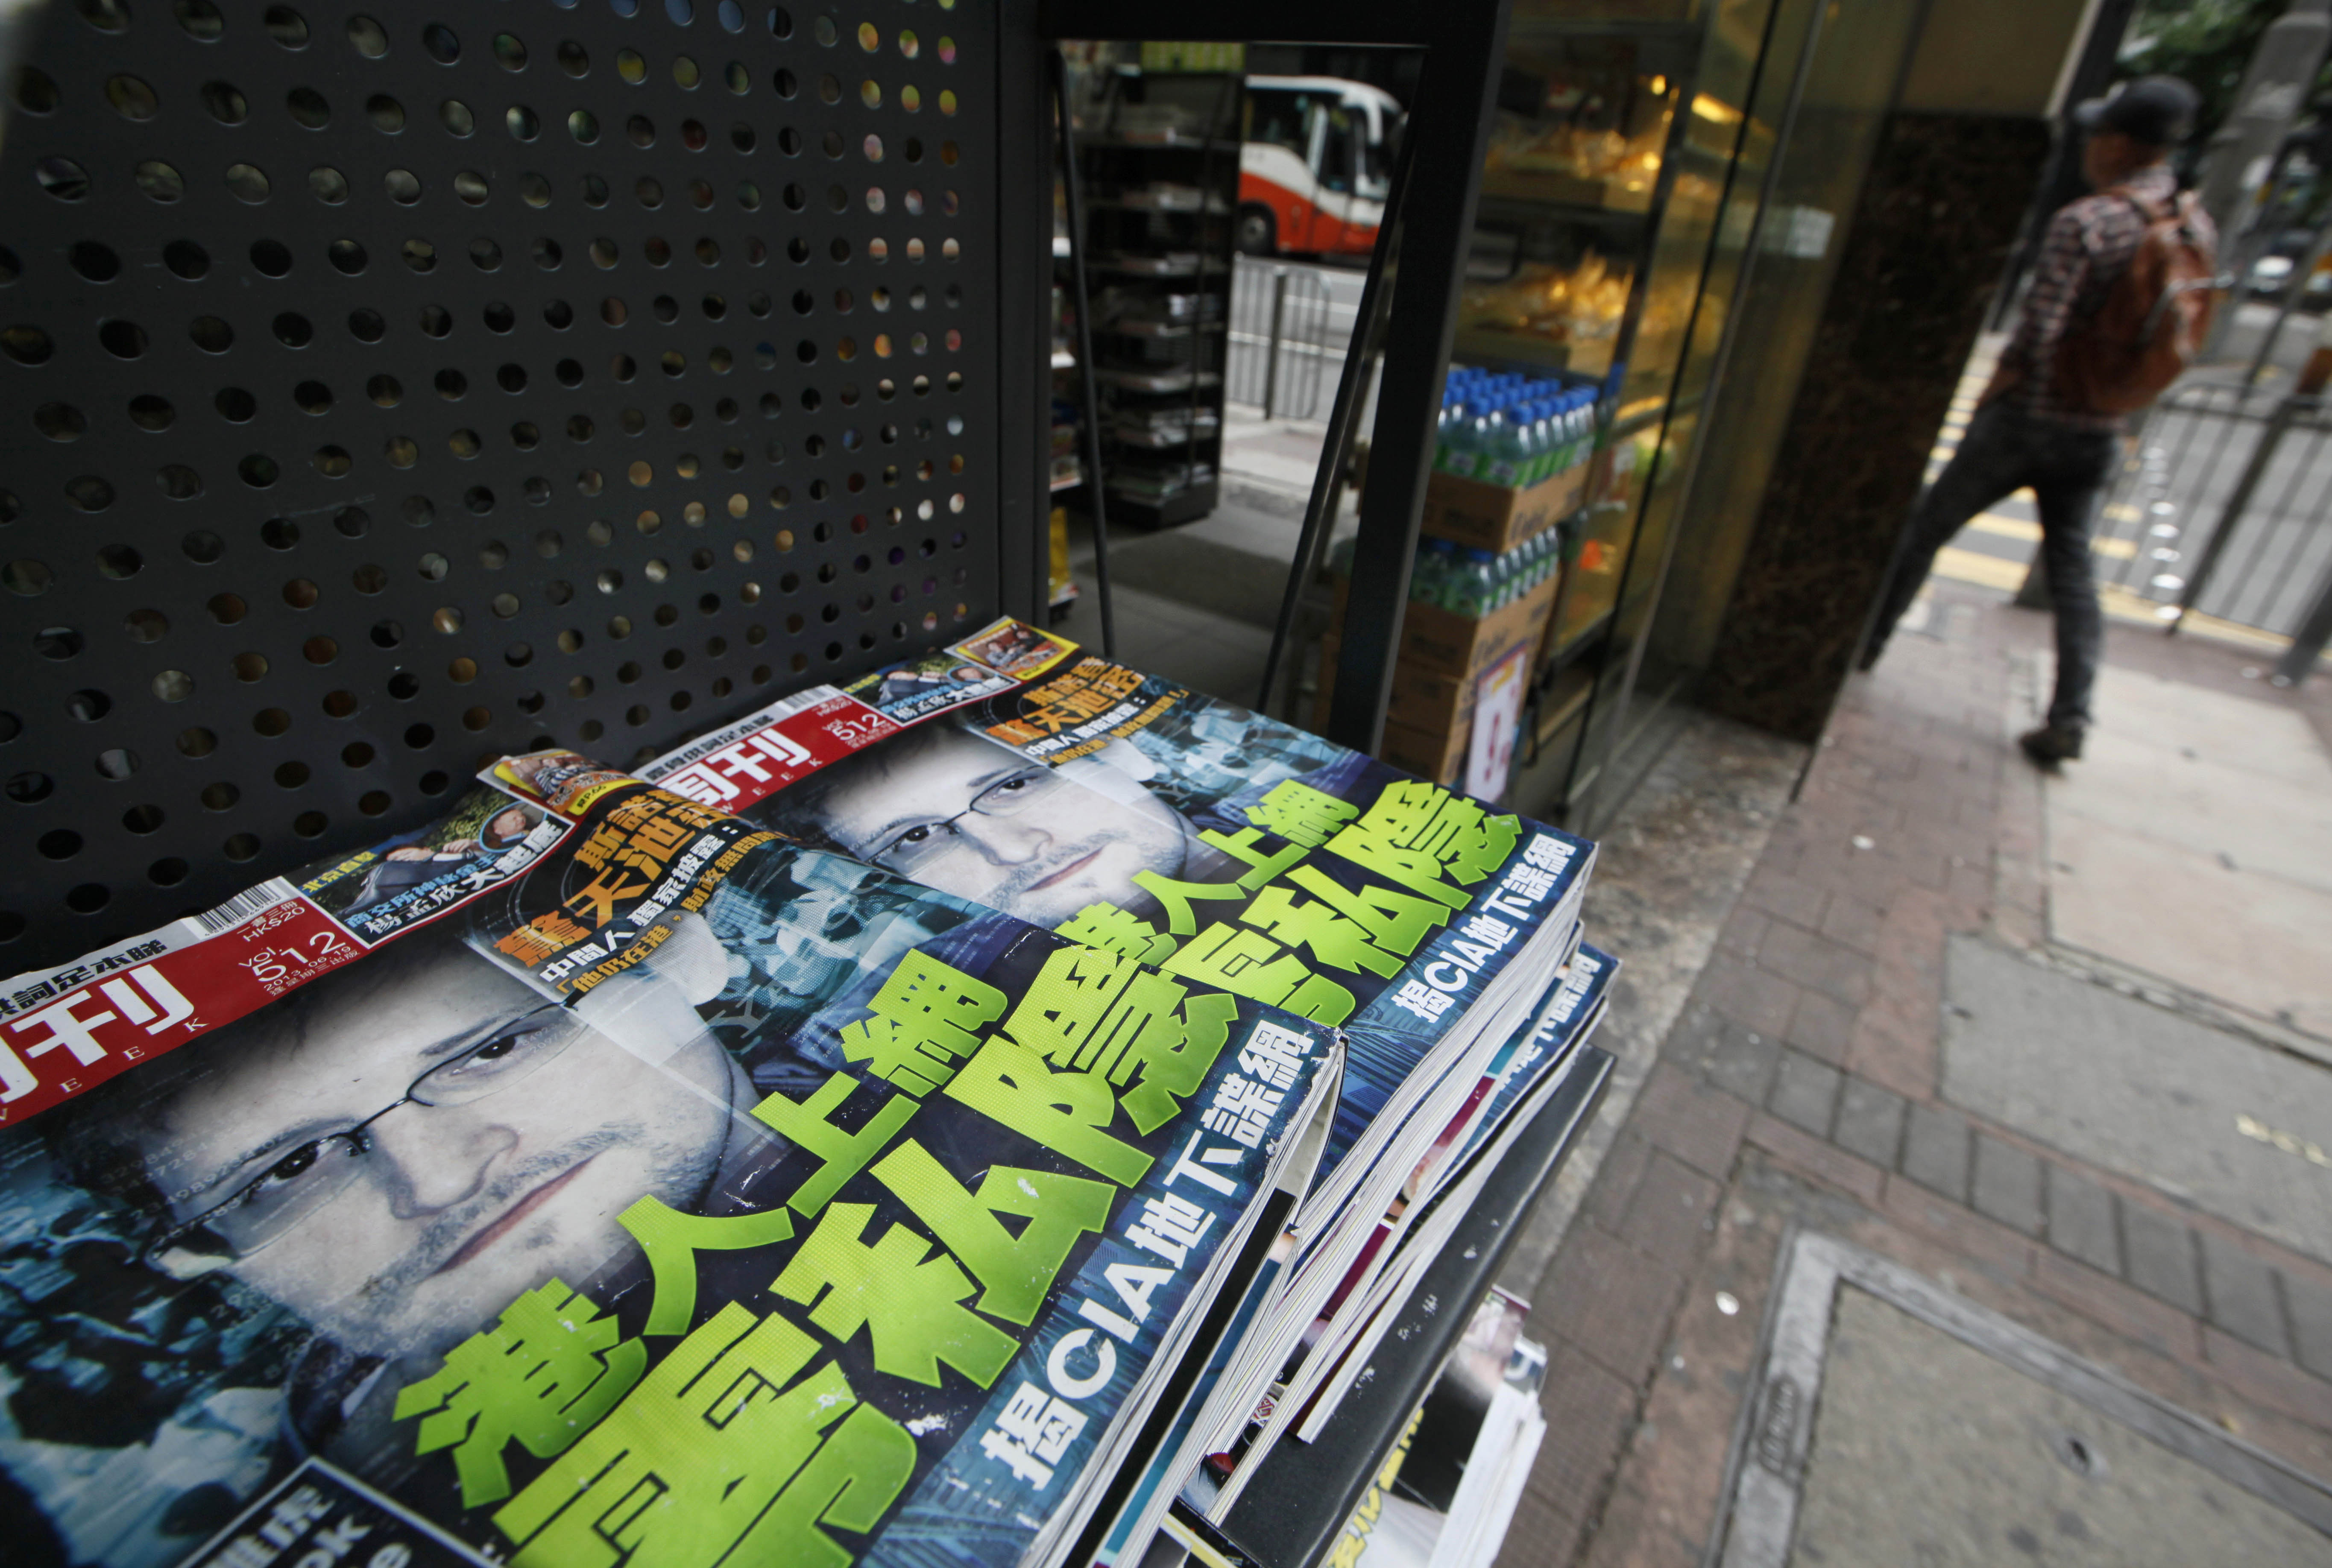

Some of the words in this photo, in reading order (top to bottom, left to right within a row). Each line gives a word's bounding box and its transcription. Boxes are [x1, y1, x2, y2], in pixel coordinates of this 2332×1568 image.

[832, 713, 886, 740] 512
[243, 907, 305, 942] HK$20
[252, 931, 346, 982] 512
[264, 946, 351, 992] 2013.06.19
[539, 929, 636, 983] 中間人
[392, 948, 1008, 1510] 港人上網
[979, 1020, 1314, 1491] 揭CIA地下諜網
